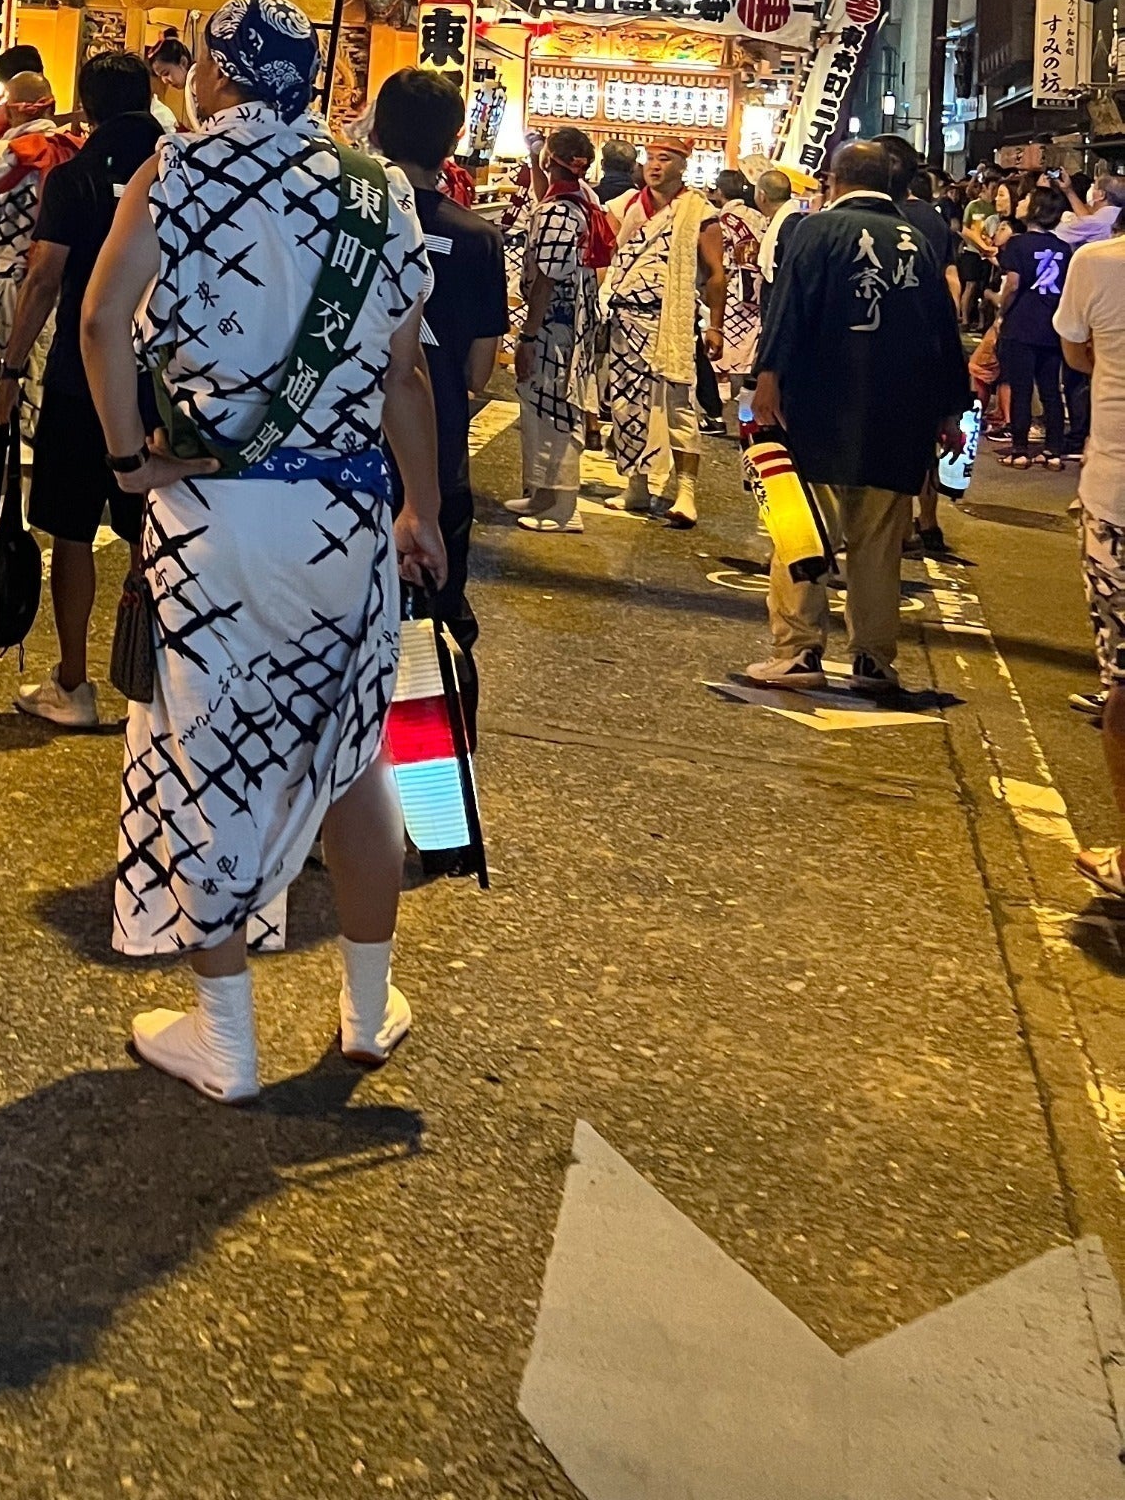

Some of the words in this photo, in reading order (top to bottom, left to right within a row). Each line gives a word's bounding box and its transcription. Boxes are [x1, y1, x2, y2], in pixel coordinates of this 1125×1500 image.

[799, 24, 865, 170] 東本町二丁目
[1041, 14, 1062, 93] すみの坊
[238, 174, 383, 464] 東町交通部
